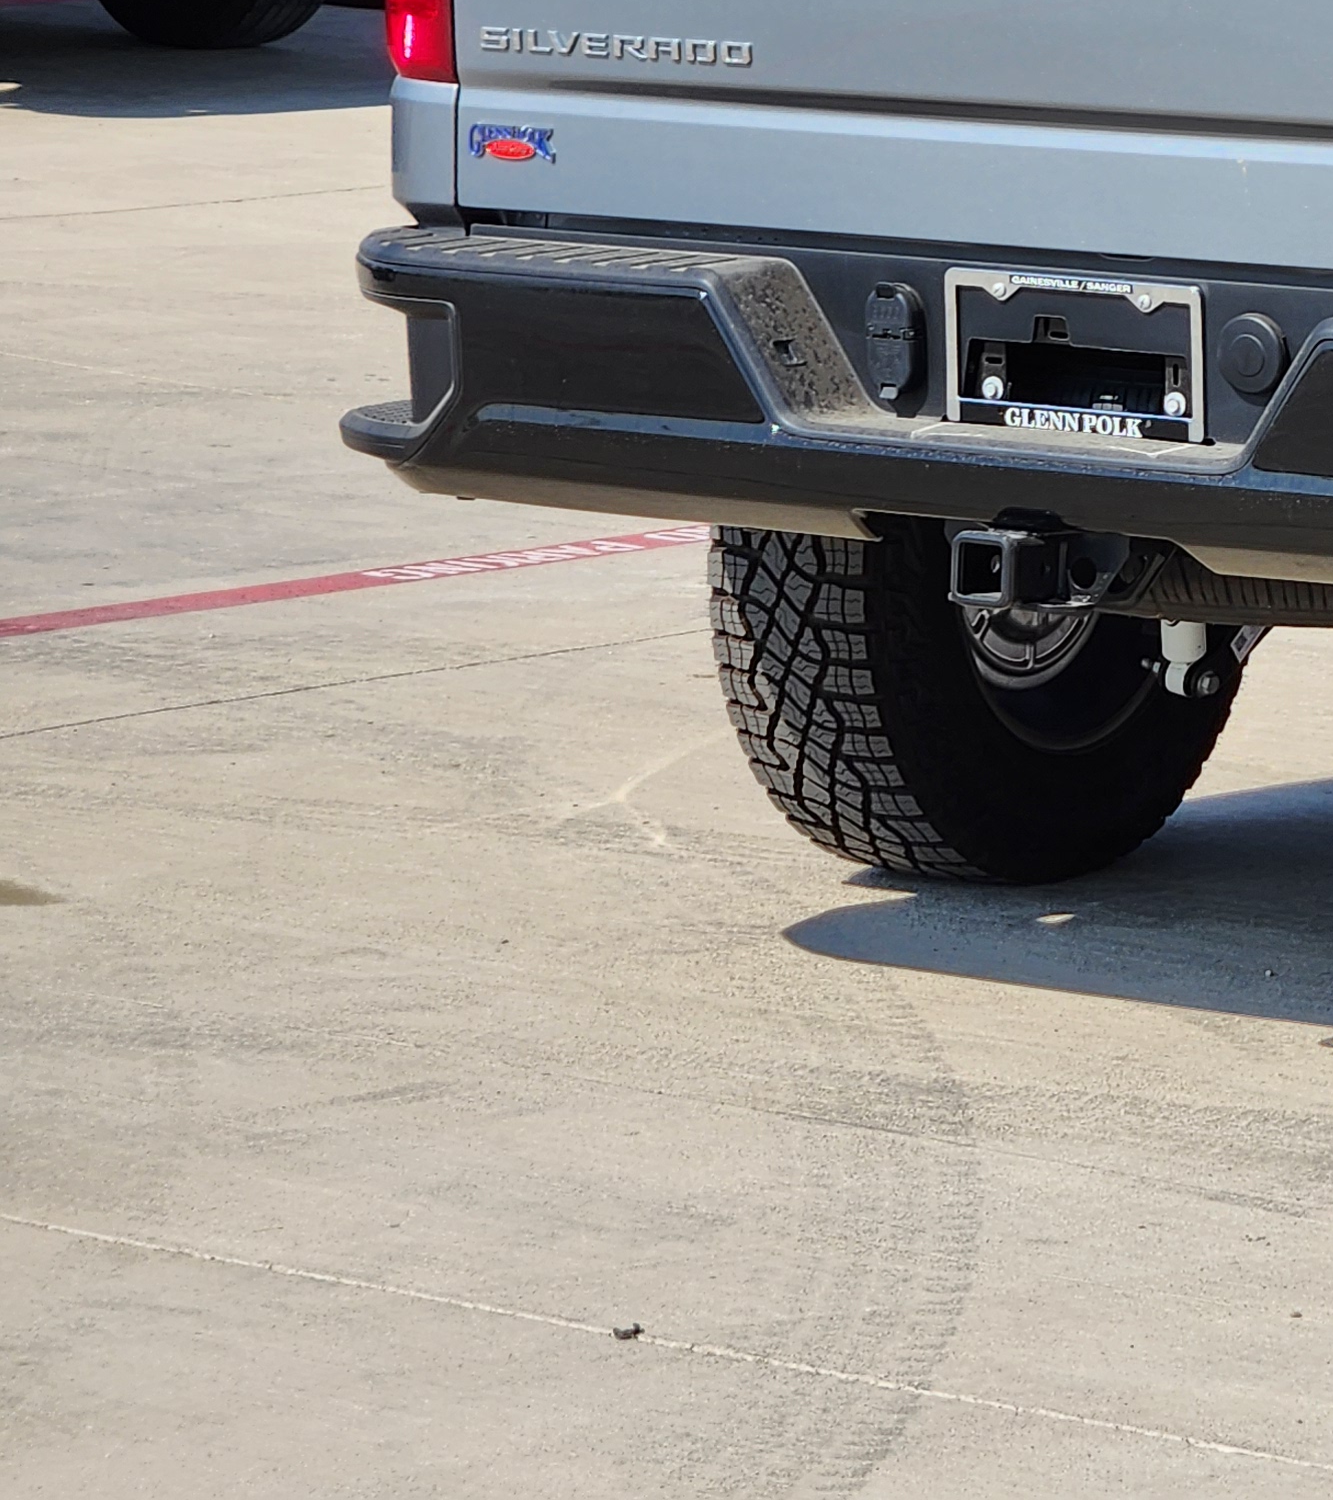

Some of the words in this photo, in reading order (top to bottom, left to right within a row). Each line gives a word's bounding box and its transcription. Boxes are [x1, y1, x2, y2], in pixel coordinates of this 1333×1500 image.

[479, 25, 754, 67] SILVERADO
[1003, 407, 1080, 432] GLENN
[1082, 414, 1143, 438] POLK
[360, 540, 645, 580] PARKING
